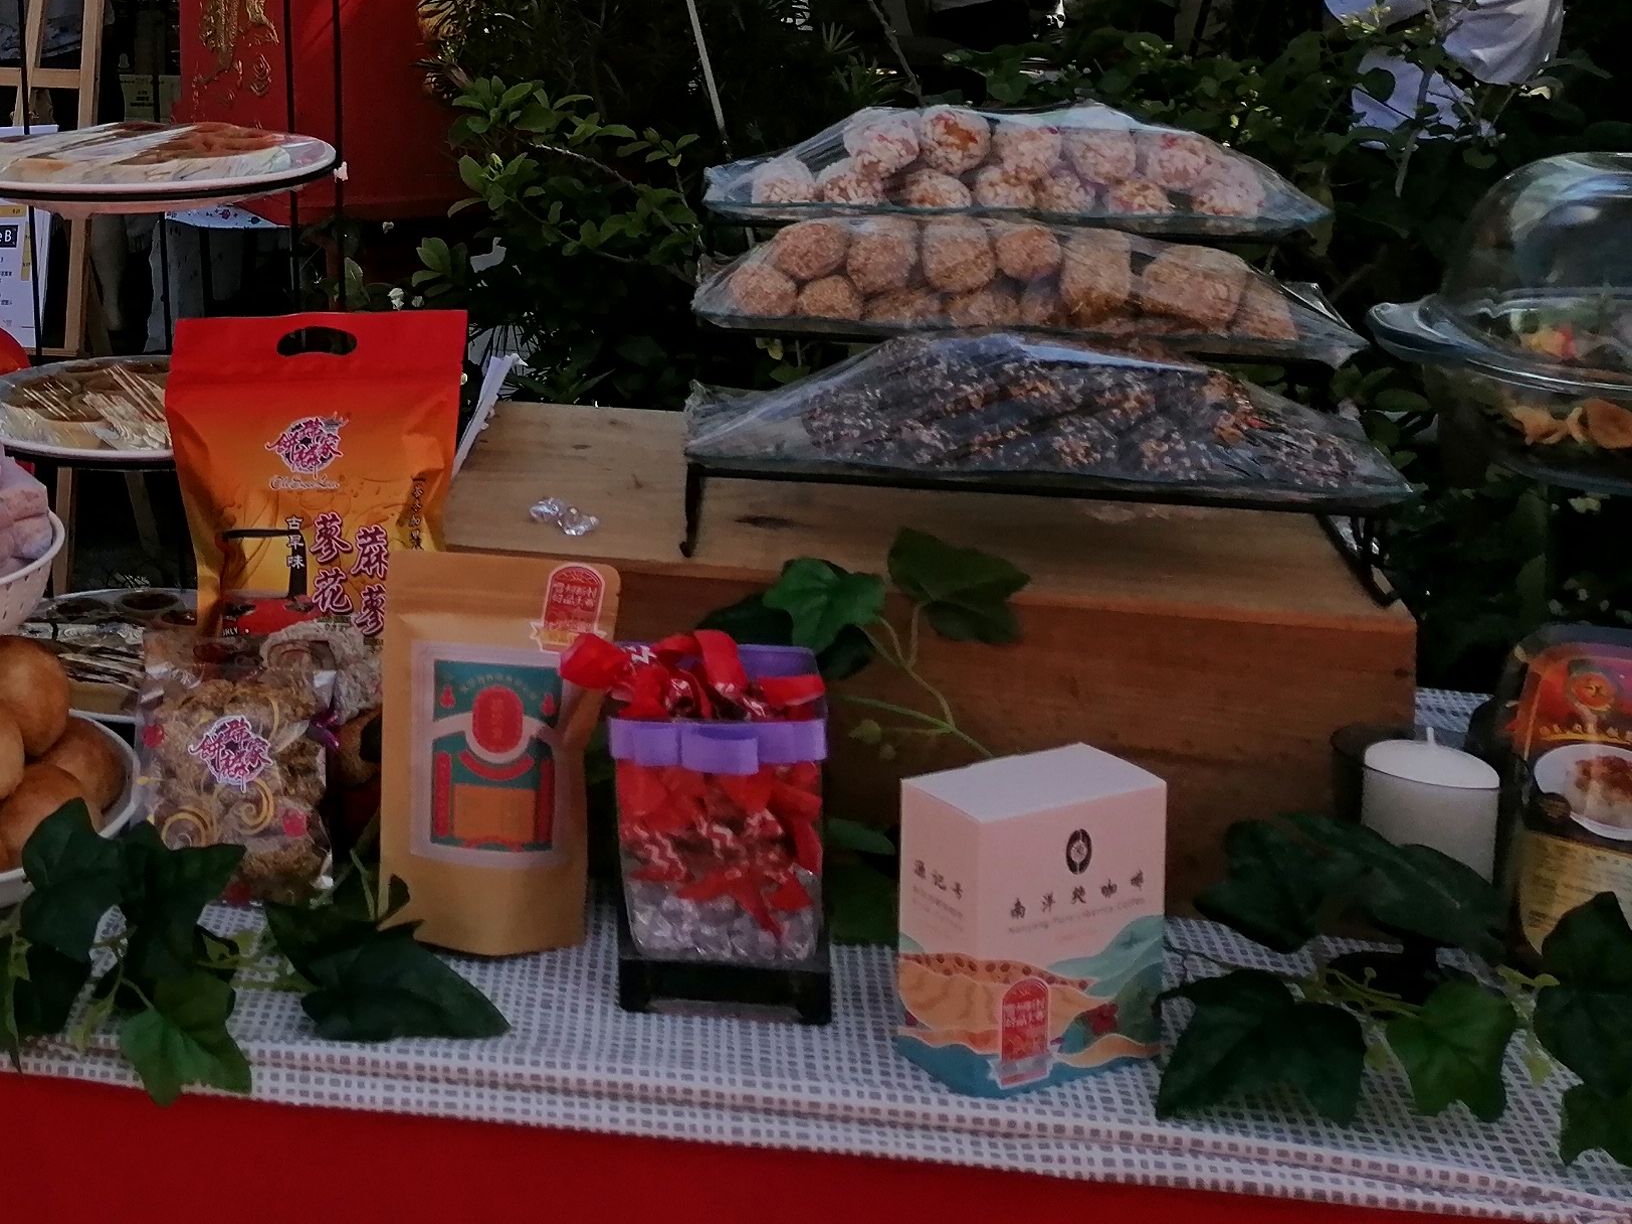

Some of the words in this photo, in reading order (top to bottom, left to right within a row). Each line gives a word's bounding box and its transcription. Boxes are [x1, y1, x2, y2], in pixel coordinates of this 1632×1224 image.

[4, 229, 12, 243] B
[285, 515, 306, 569] 古早味
